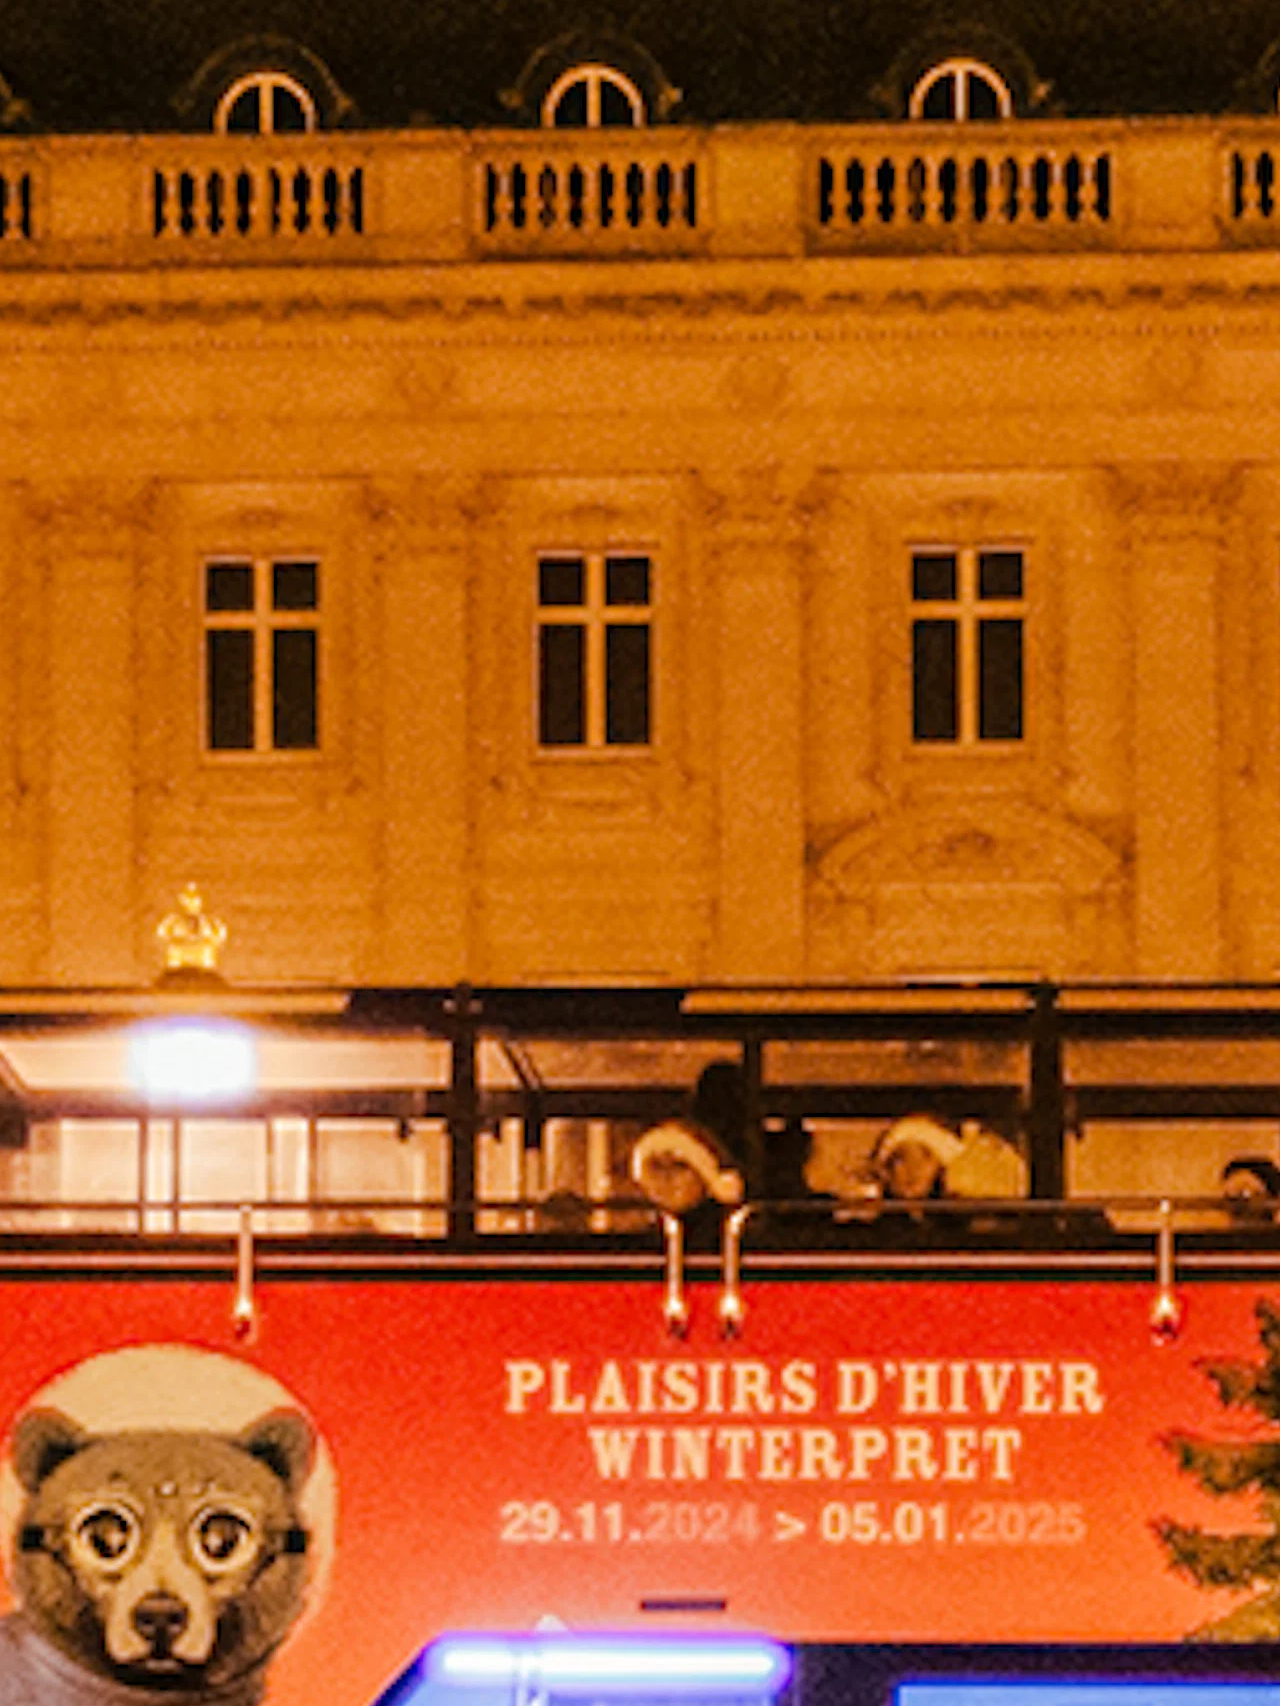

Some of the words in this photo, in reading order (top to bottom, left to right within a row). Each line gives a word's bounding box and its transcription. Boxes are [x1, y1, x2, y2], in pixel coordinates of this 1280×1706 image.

[505, 1359, 818, 1414] PLAISIRS
[837, 1359, 1106, 1414] D'HIVER
[588, 1427, 1023, 1481] WINTERPRET
[500, 1500, 761, 1543] 29.11.2024
[821, 1500, 1087, 1543] 05.01.2025
